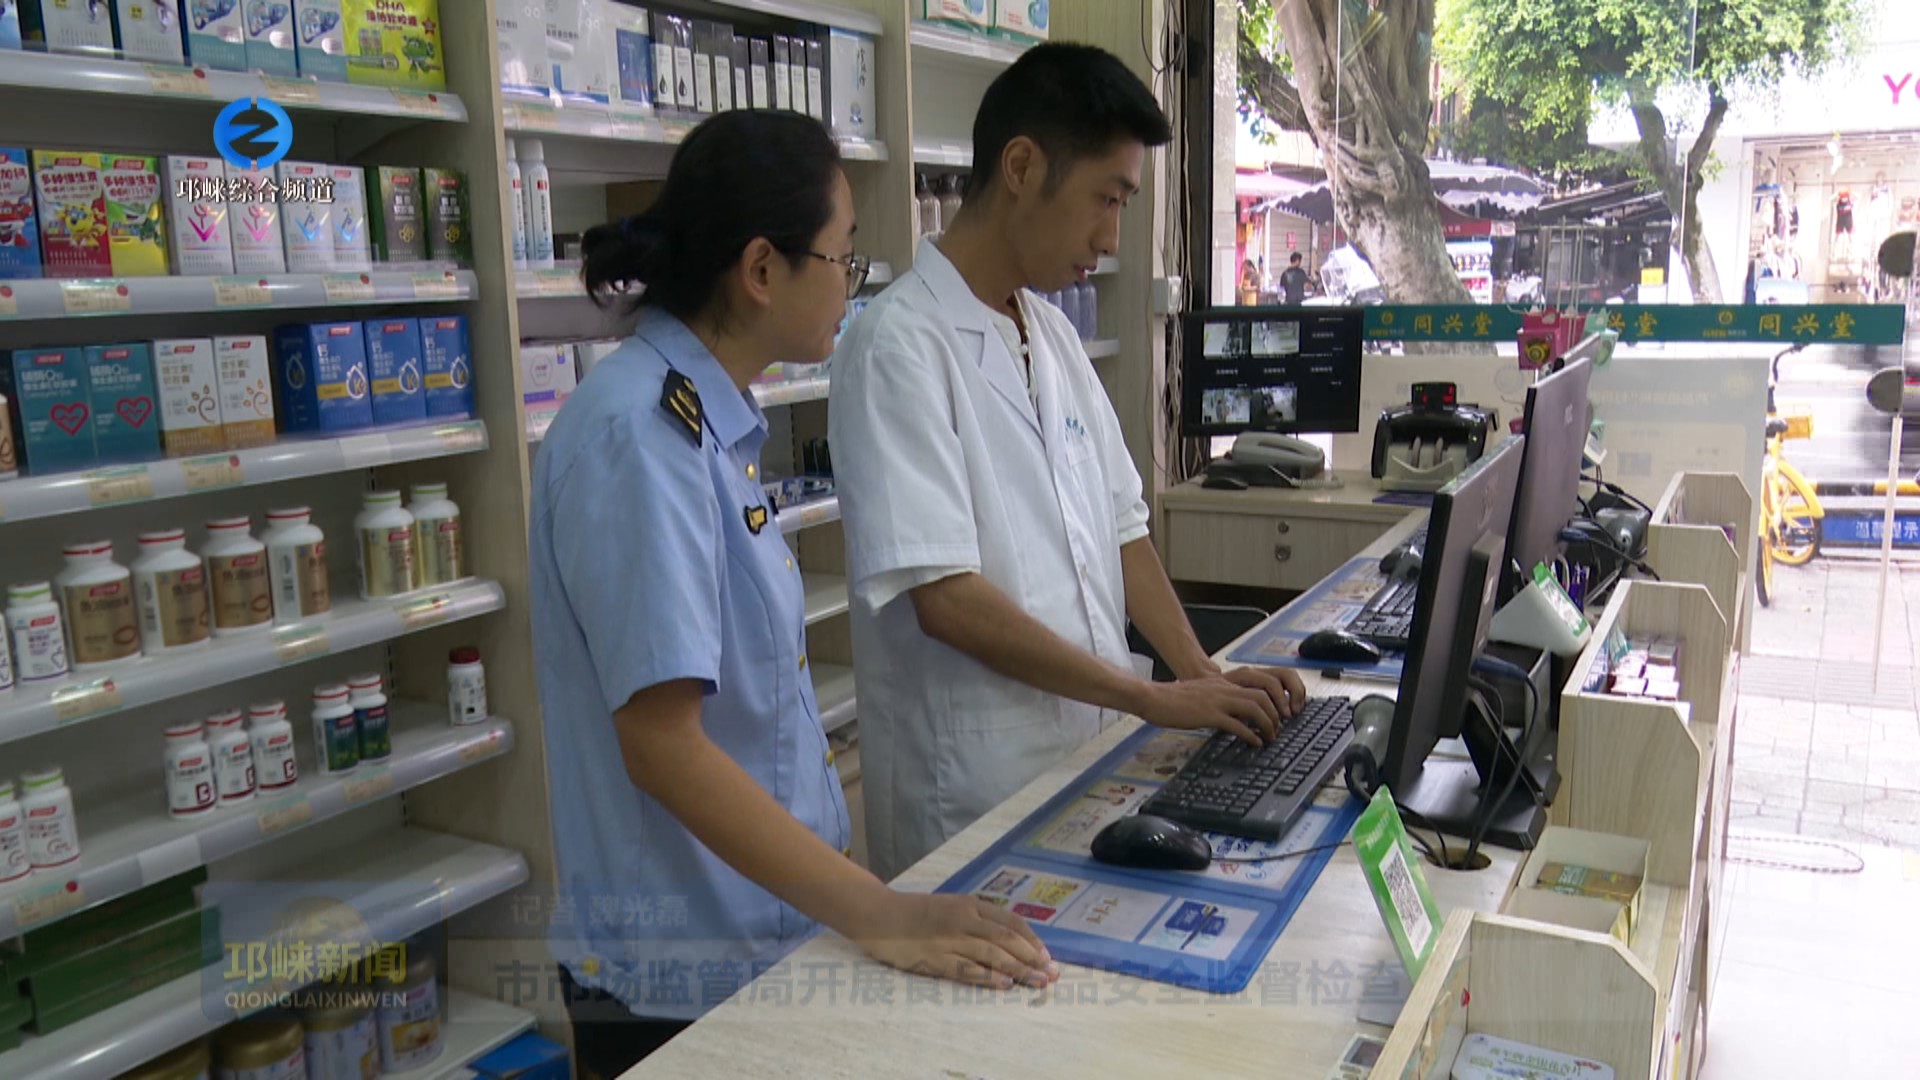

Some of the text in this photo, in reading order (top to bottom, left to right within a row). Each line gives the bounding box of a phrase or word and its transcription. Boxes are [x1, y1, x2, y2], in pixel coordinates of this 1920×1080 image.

[1882, 72, 1920, 105] Y
[1414, 311, 1492, 336] 同兴堂
[1759, 311, 1855, 338] 同兴堂
